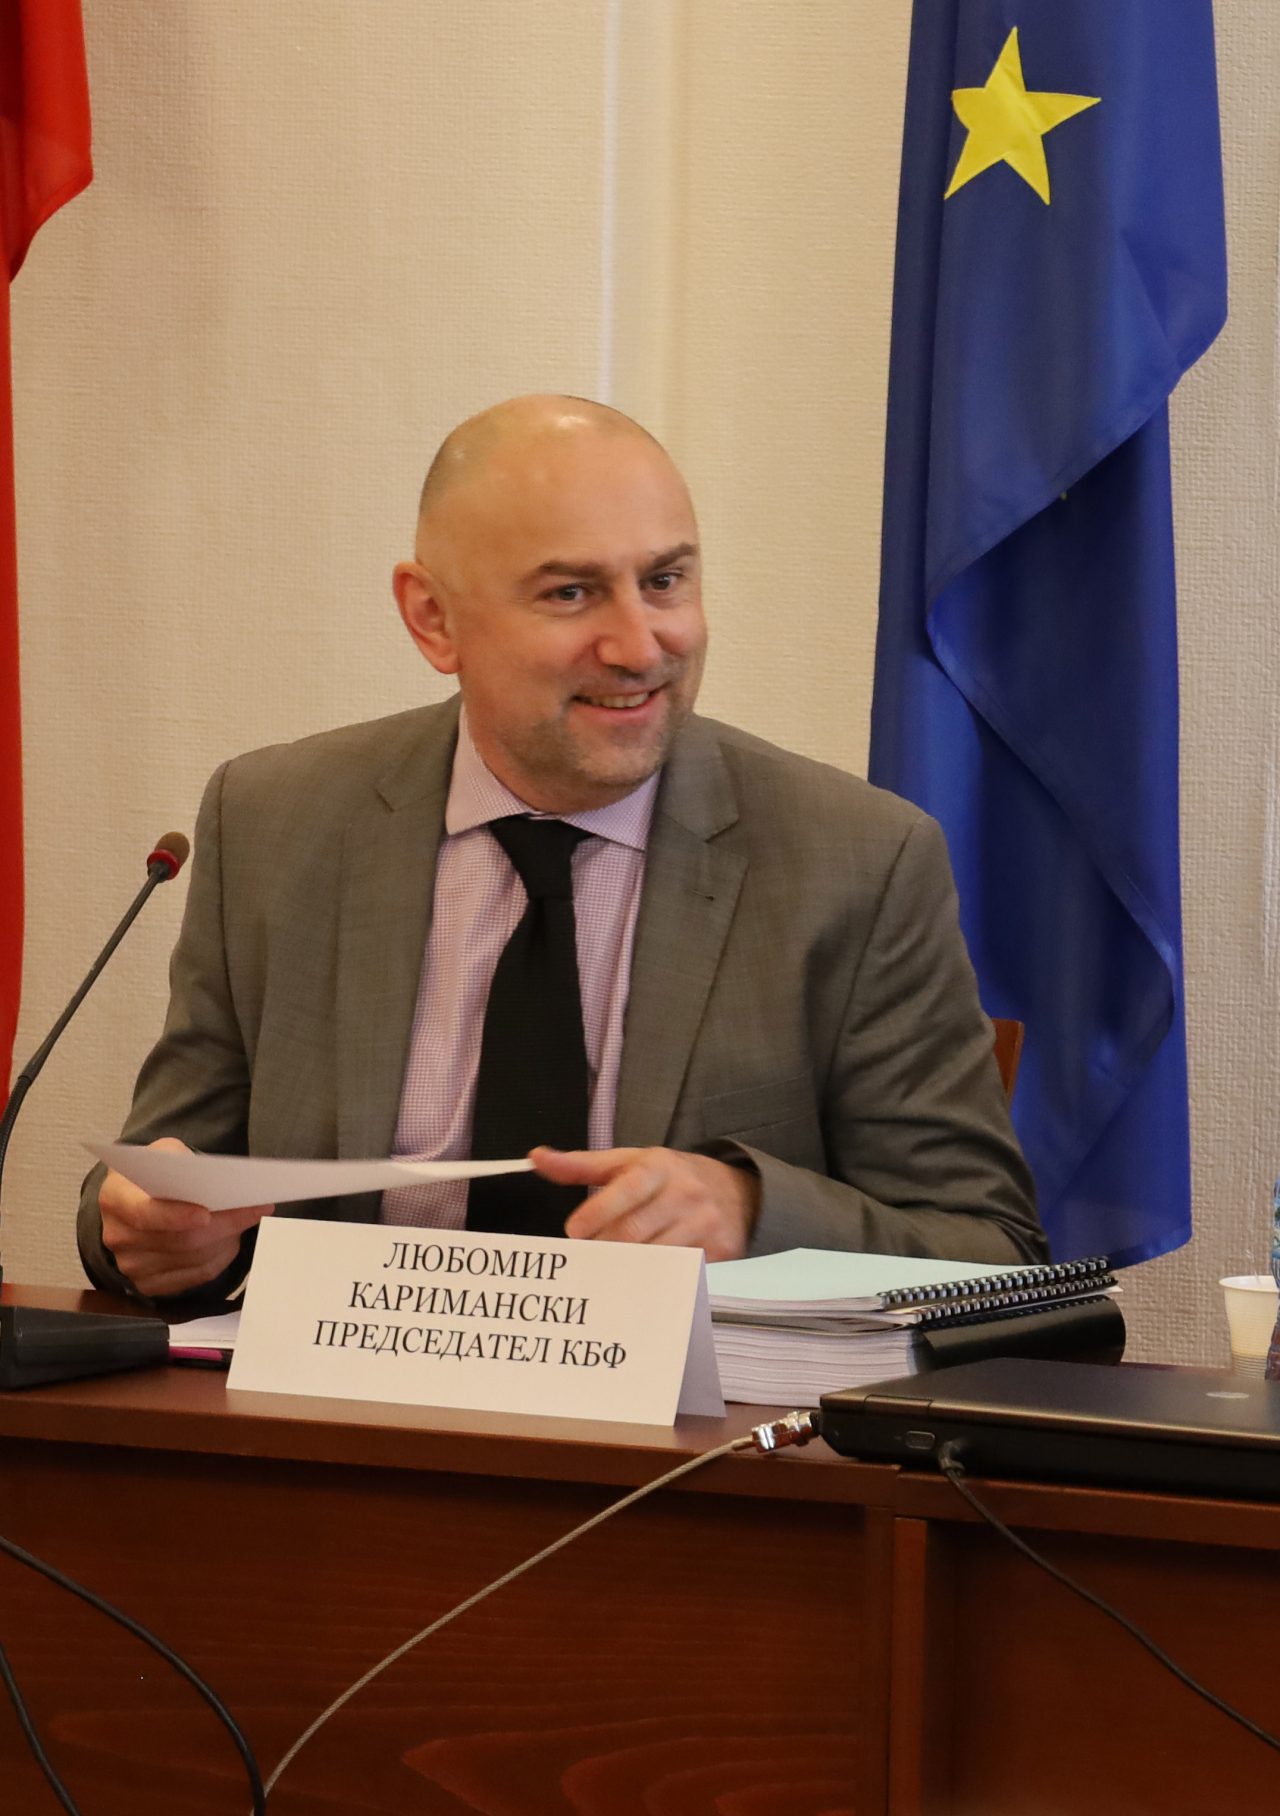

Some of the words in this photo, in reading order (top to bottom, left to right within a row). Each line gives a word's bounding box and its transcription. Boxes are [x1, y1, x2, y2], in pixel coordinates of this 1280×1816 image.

[382, 1242, 568, 1281] ЛЮБОМИР
[348, 1281, 589, 1325] КАРИМАНСКИ
[312, 1320, 551, 1363] ПРЕДСЕДАТЕЛ
[559, 1339, 627, 1369] КБФ
